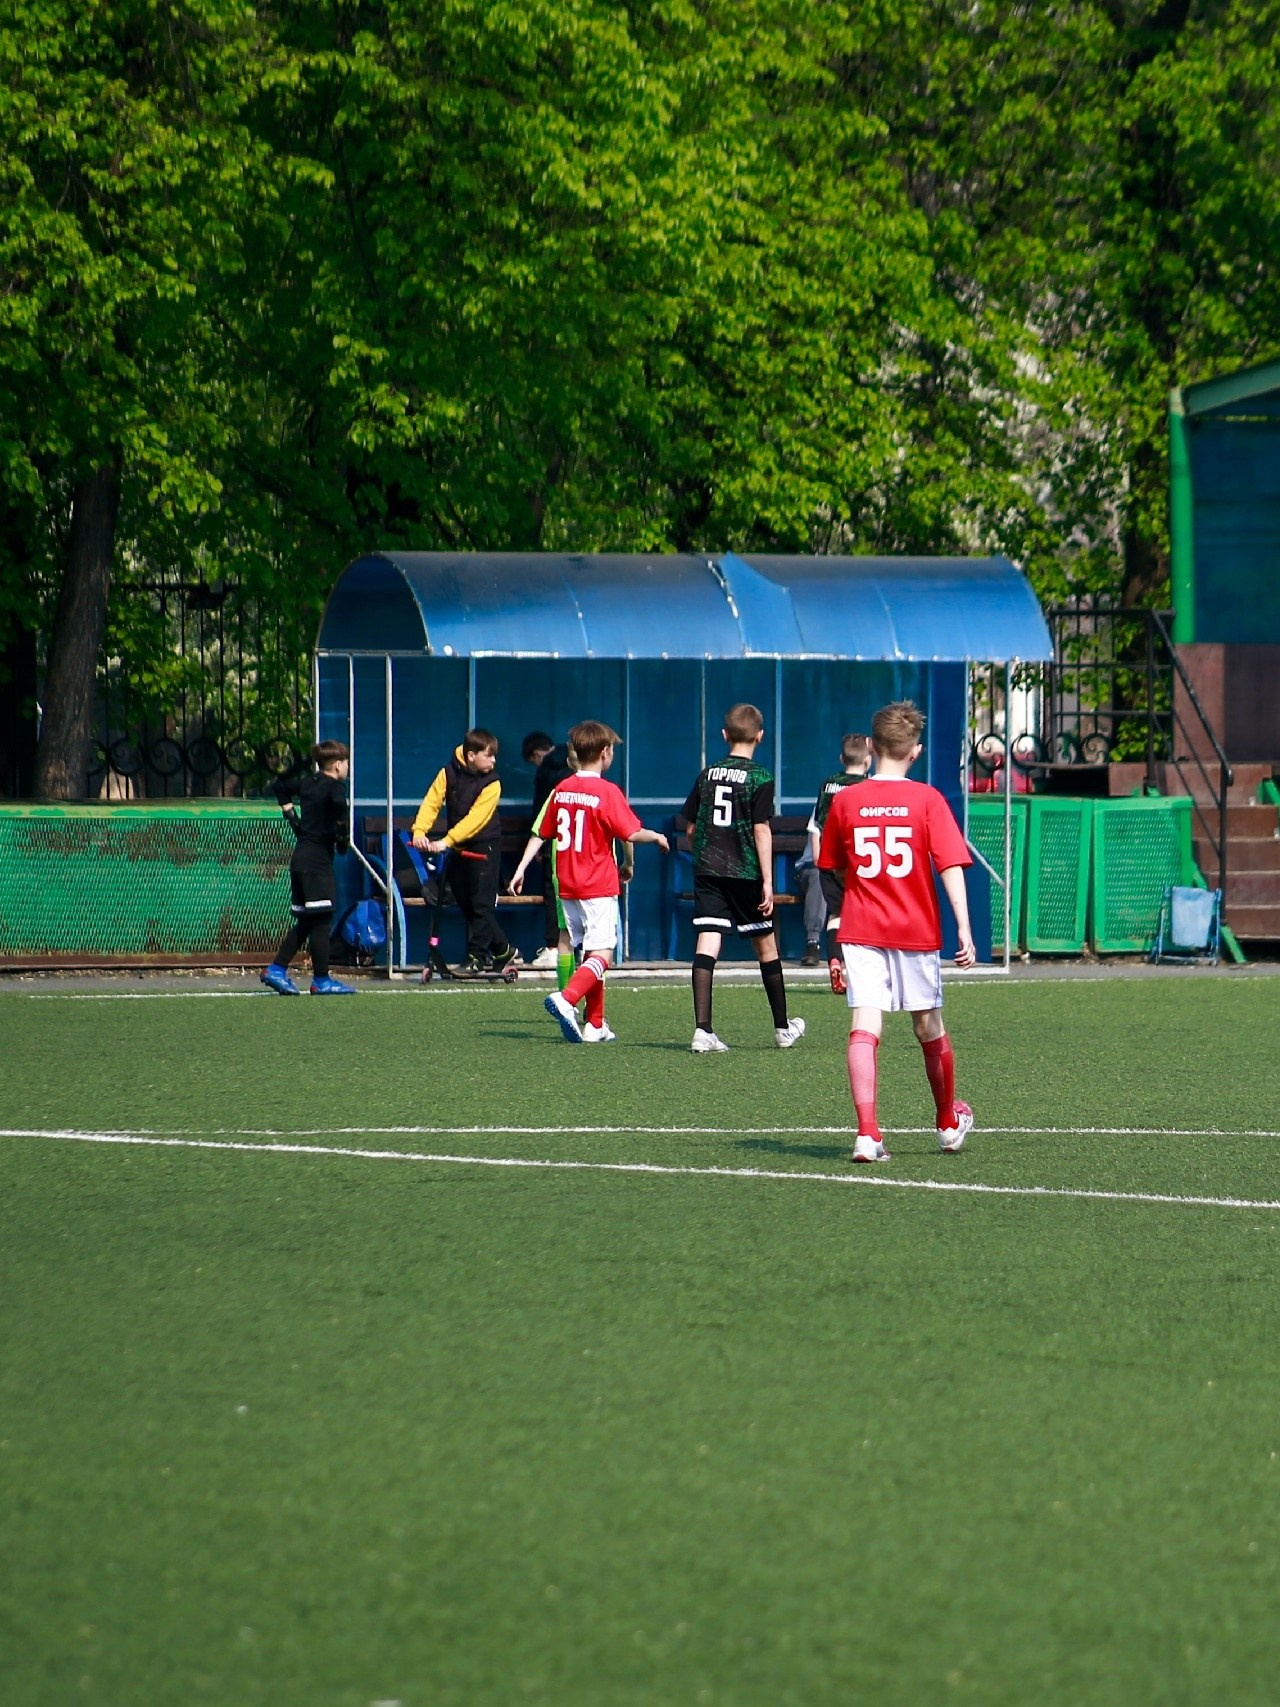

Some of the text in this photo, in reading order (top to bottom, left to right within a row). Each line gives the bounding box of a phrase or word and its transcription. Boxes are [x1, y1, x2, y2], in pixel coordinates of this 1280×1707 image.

[713, 784, 733, 827] 5
[859, 806, 909, 817] ФИРСОВ
[556, 807, 586, 853] 31
[853, 826, 913, 879] 55
